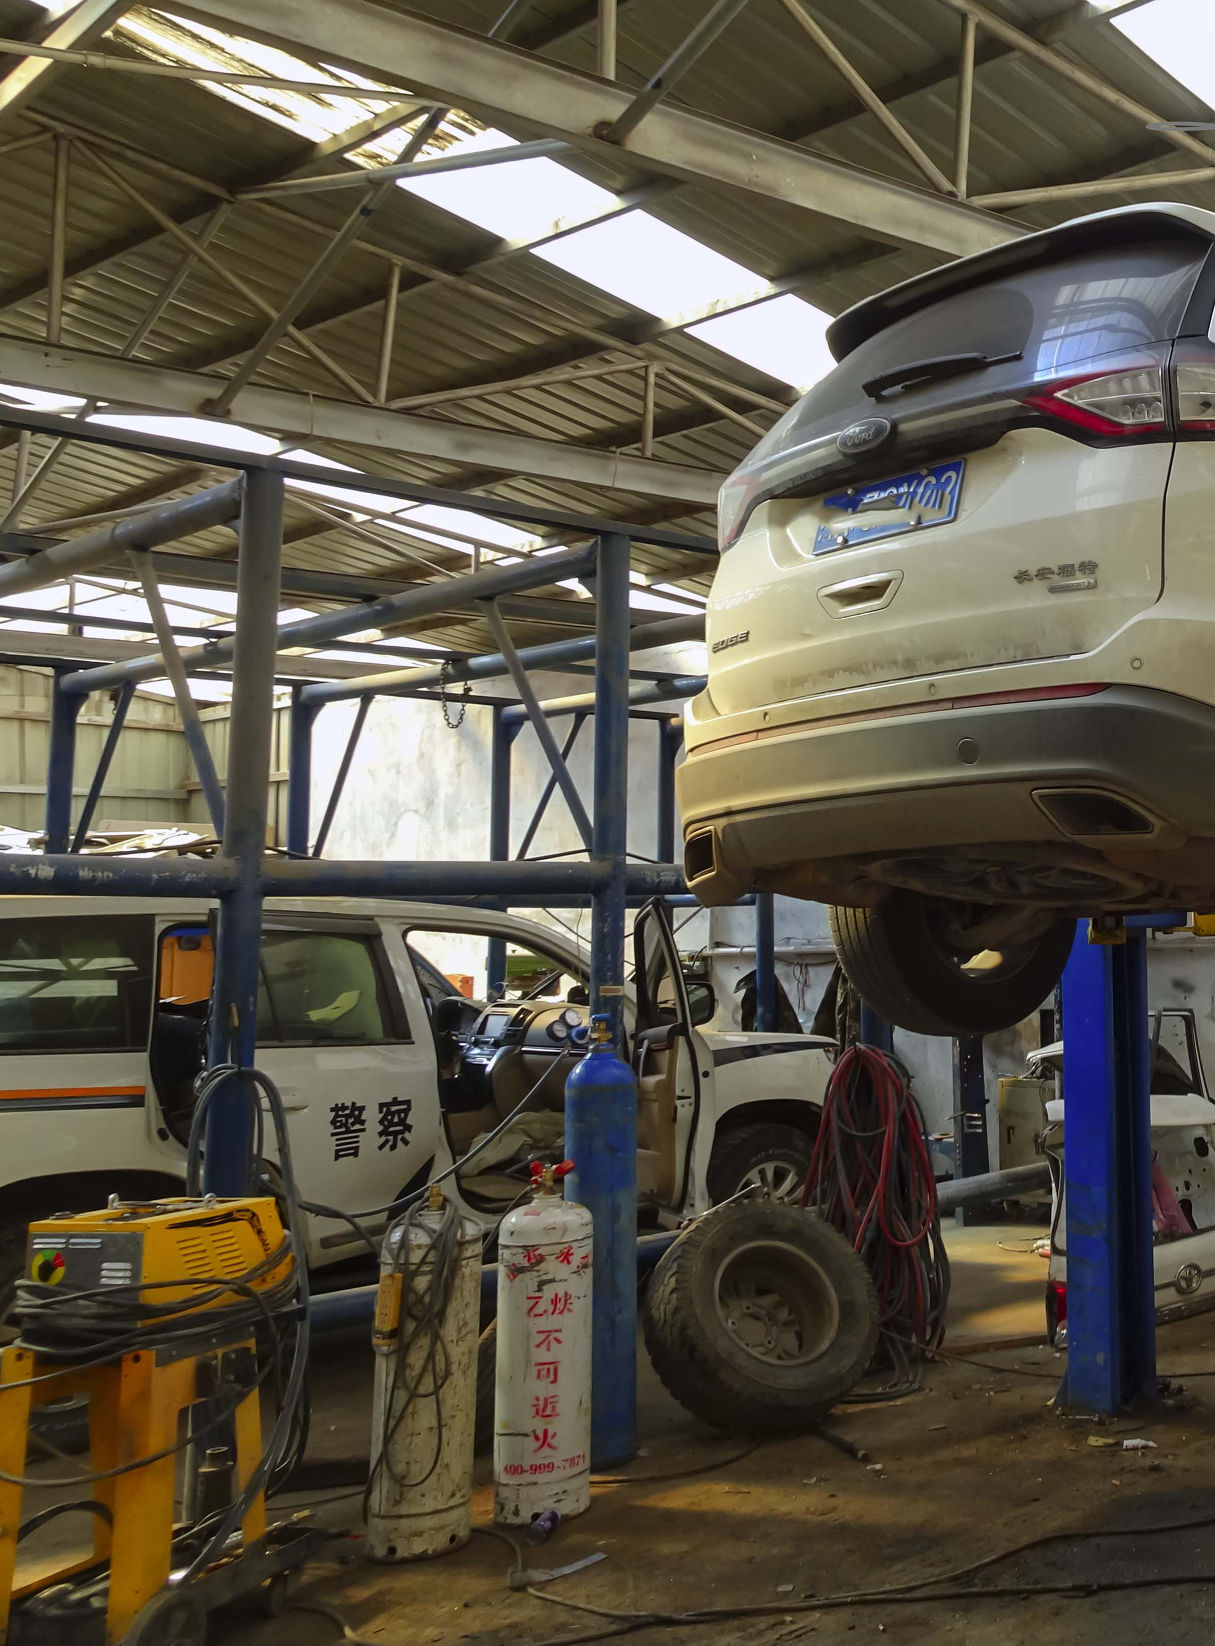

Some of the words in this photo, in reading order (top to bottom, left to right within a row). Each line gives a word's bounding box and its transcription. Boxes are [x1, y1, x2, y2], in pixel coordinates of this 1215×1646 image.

[1013, 560, 1099, 585] 长安福特
[711, 630, 750, 654] EDGE
[330, 1096, 413, 1161] 警察
[532, 1328, 562, 1454] 不可近火
